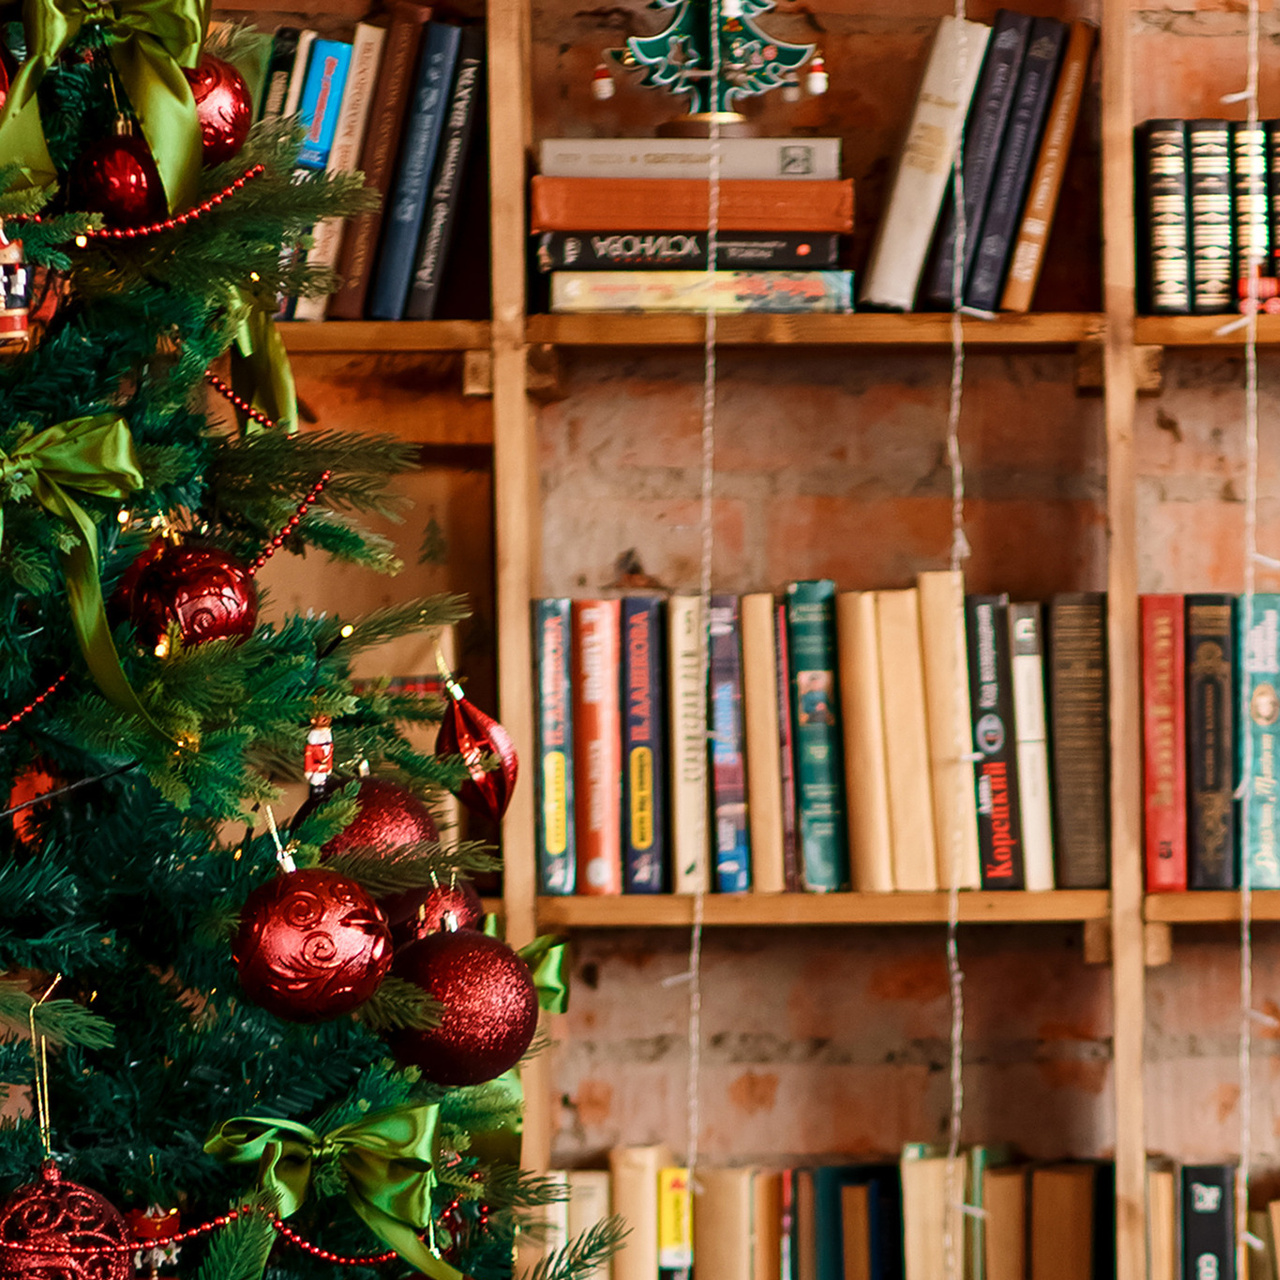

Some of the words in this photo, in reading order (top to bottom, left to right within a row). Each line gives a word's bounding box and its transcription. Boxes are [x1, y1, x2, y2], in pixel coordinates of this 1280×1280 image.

[591, 234, 701, 258] УСТИНОВА
[629, 611, 650, 718] ДАШКОВА
[982, 761, 1016, 879] Корецкий
